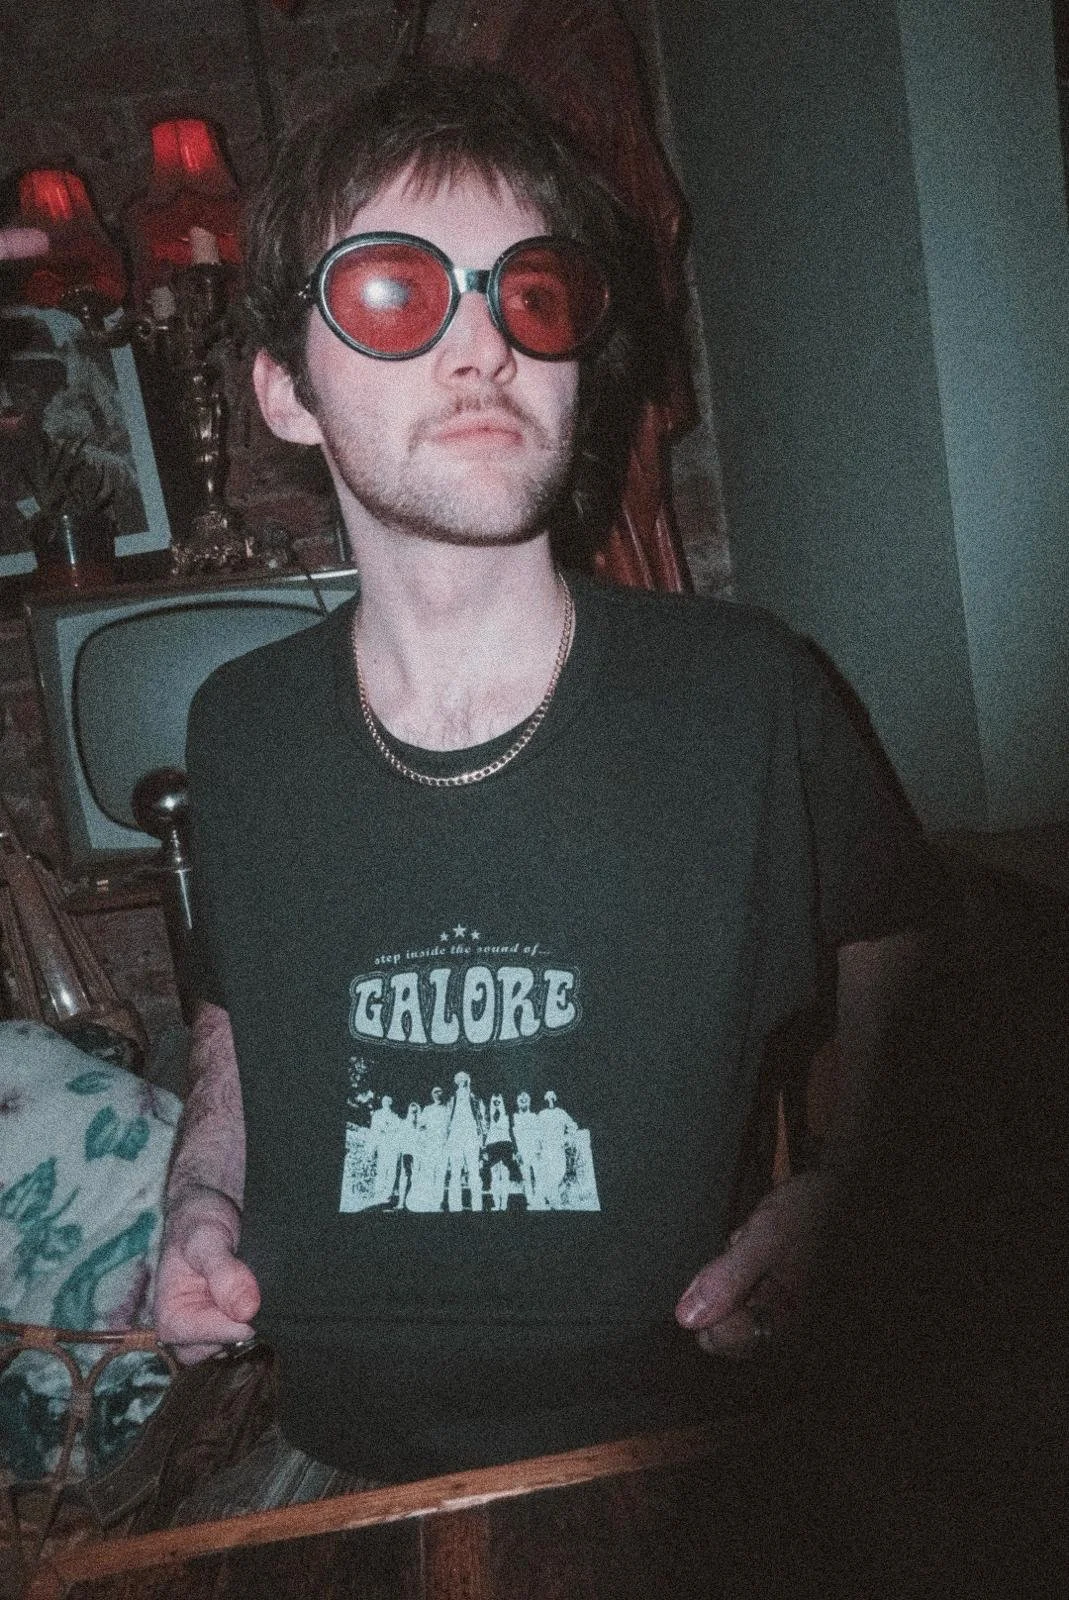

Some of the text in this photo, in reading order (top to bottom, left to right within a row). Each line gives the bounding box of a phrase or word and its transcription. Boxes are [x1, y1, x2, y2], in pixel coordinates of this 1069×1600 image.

[374, 953, 401, 965] step
[406, 946, 446, 960] inside
[450, 944, 471, 955] the
[478, 943, 519, 954] sound
[354, 966, 576, 1044] GALORE
